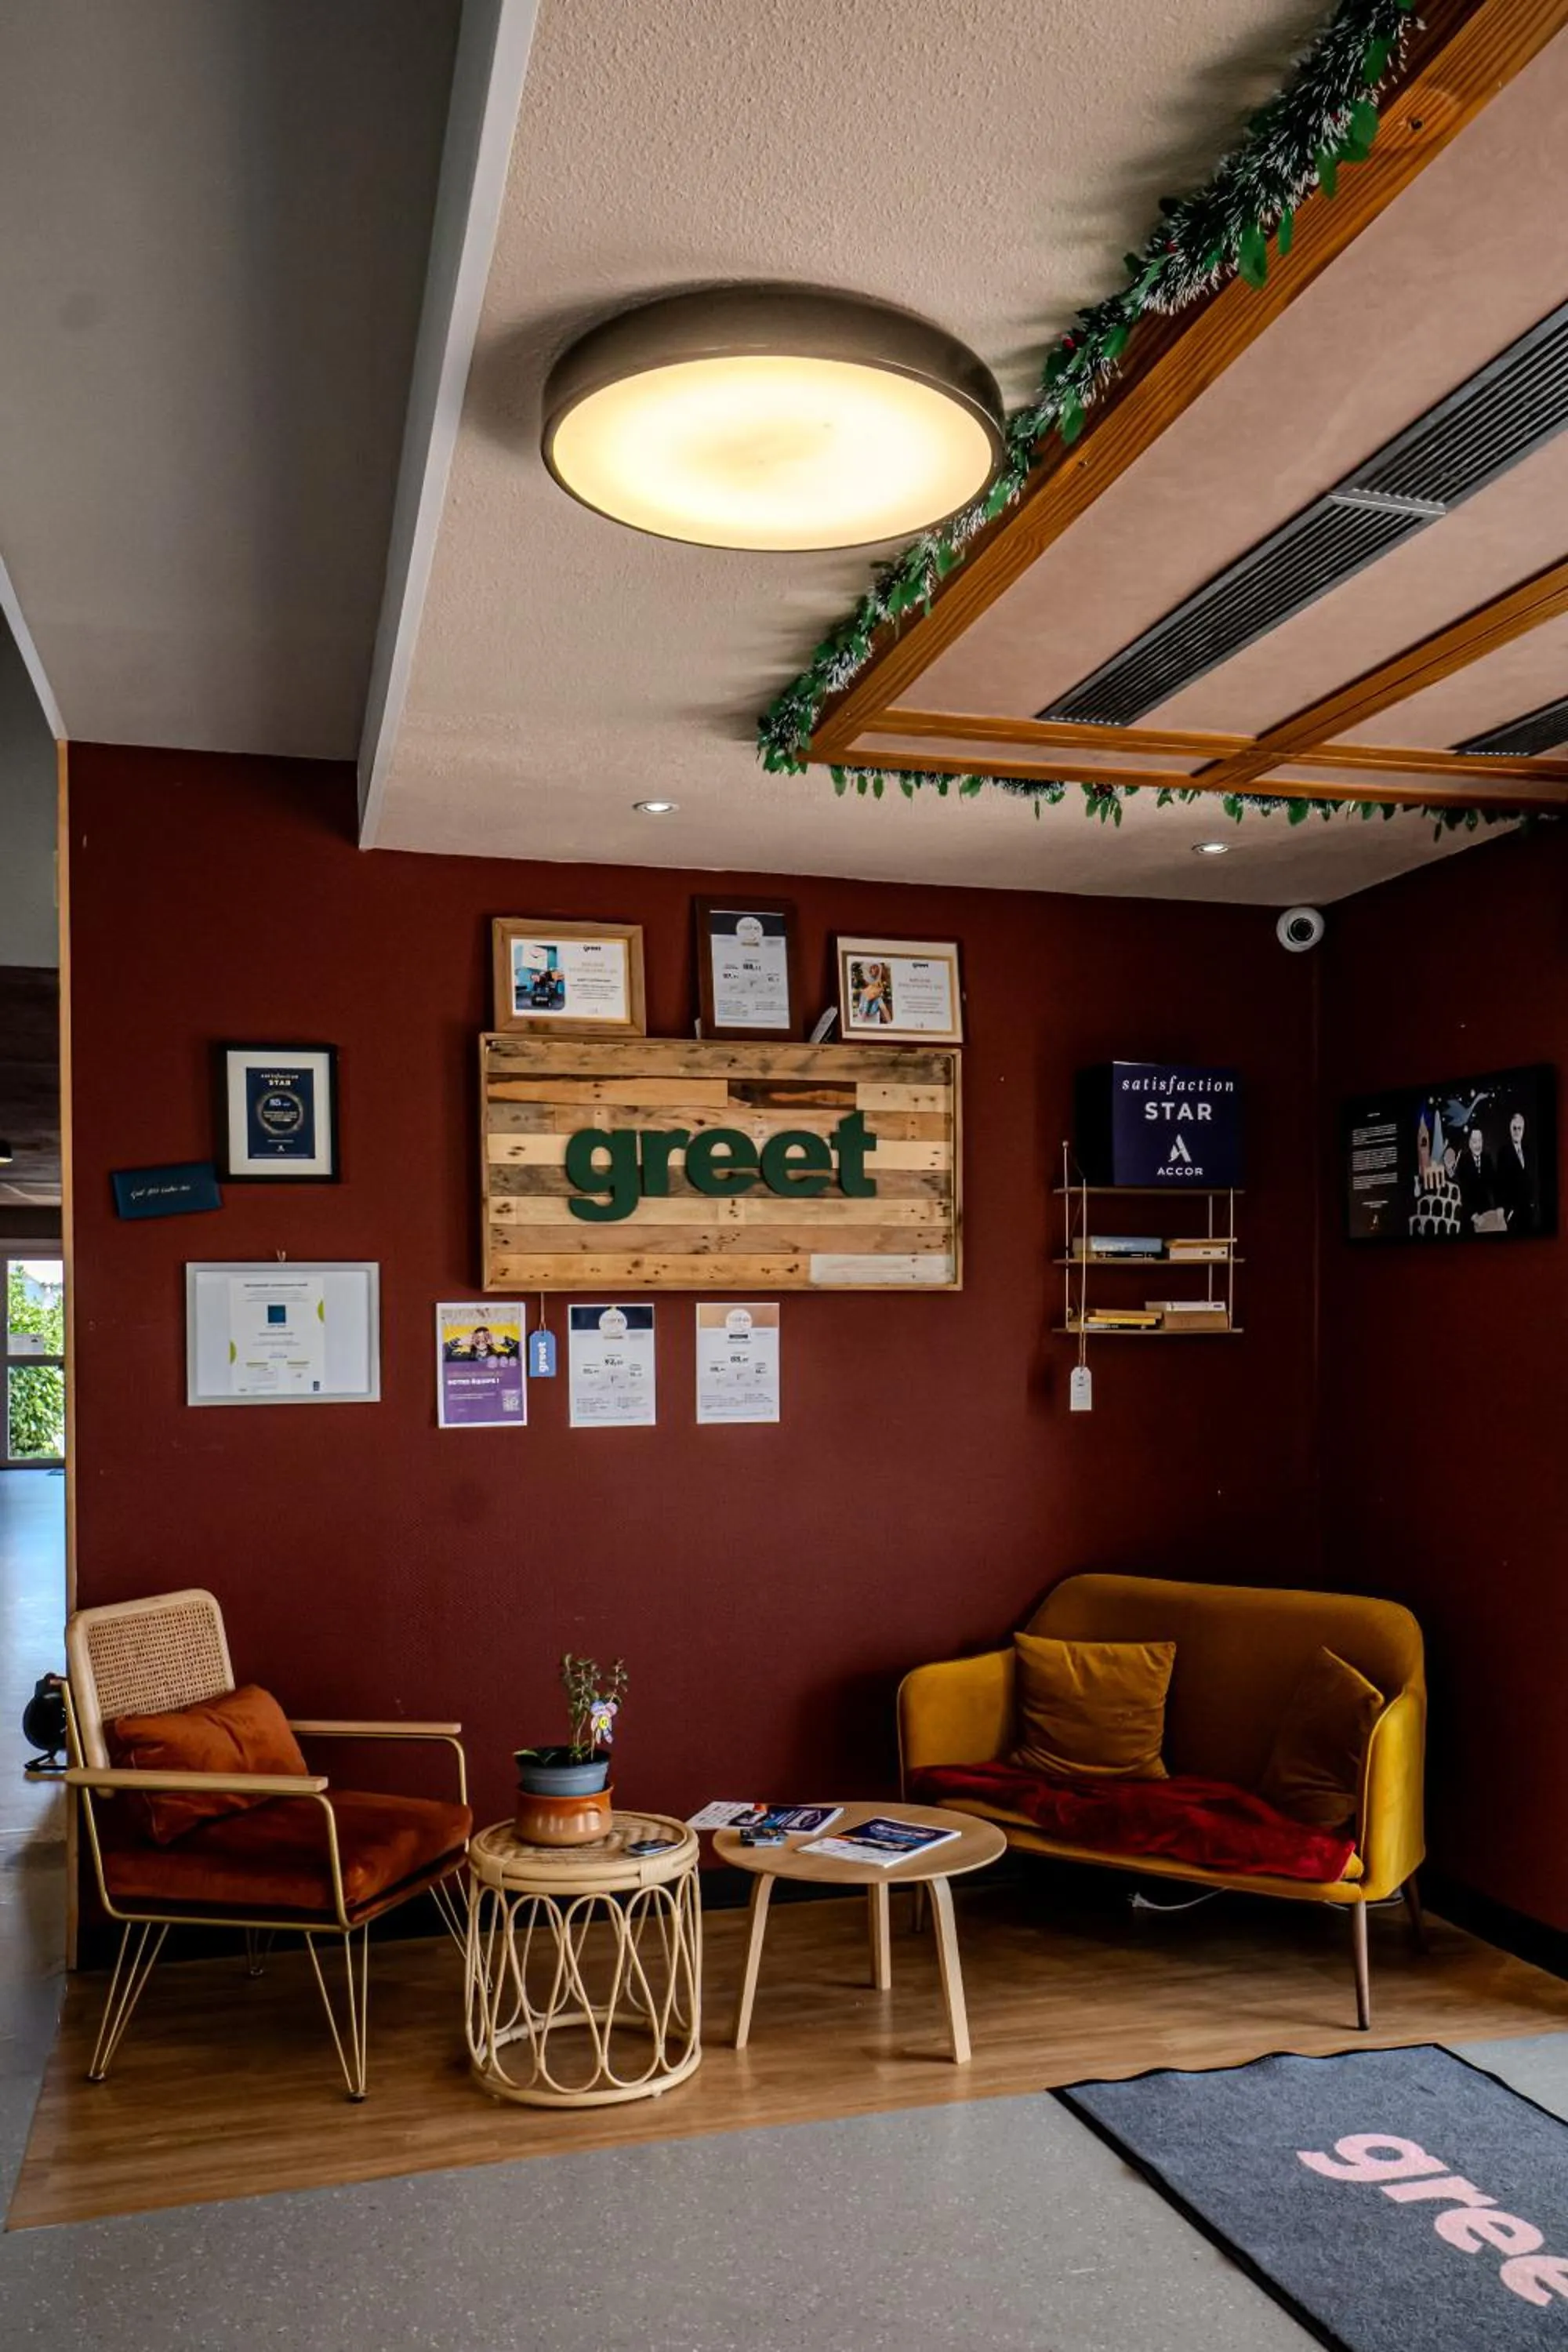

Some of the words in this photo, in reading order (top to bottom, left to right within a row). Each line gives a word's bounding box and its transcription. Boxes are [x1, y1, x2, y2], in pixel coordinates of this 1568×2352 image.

[1122, 1075, 1234, 1095] satisfaction
[1145, 1102, 1212, 1120] STAR
[565, 1109, 877, 1222] greet
[1157, 1167, 1203, 1176] ACCOR
[538, 1341, 550, 1373] greet
